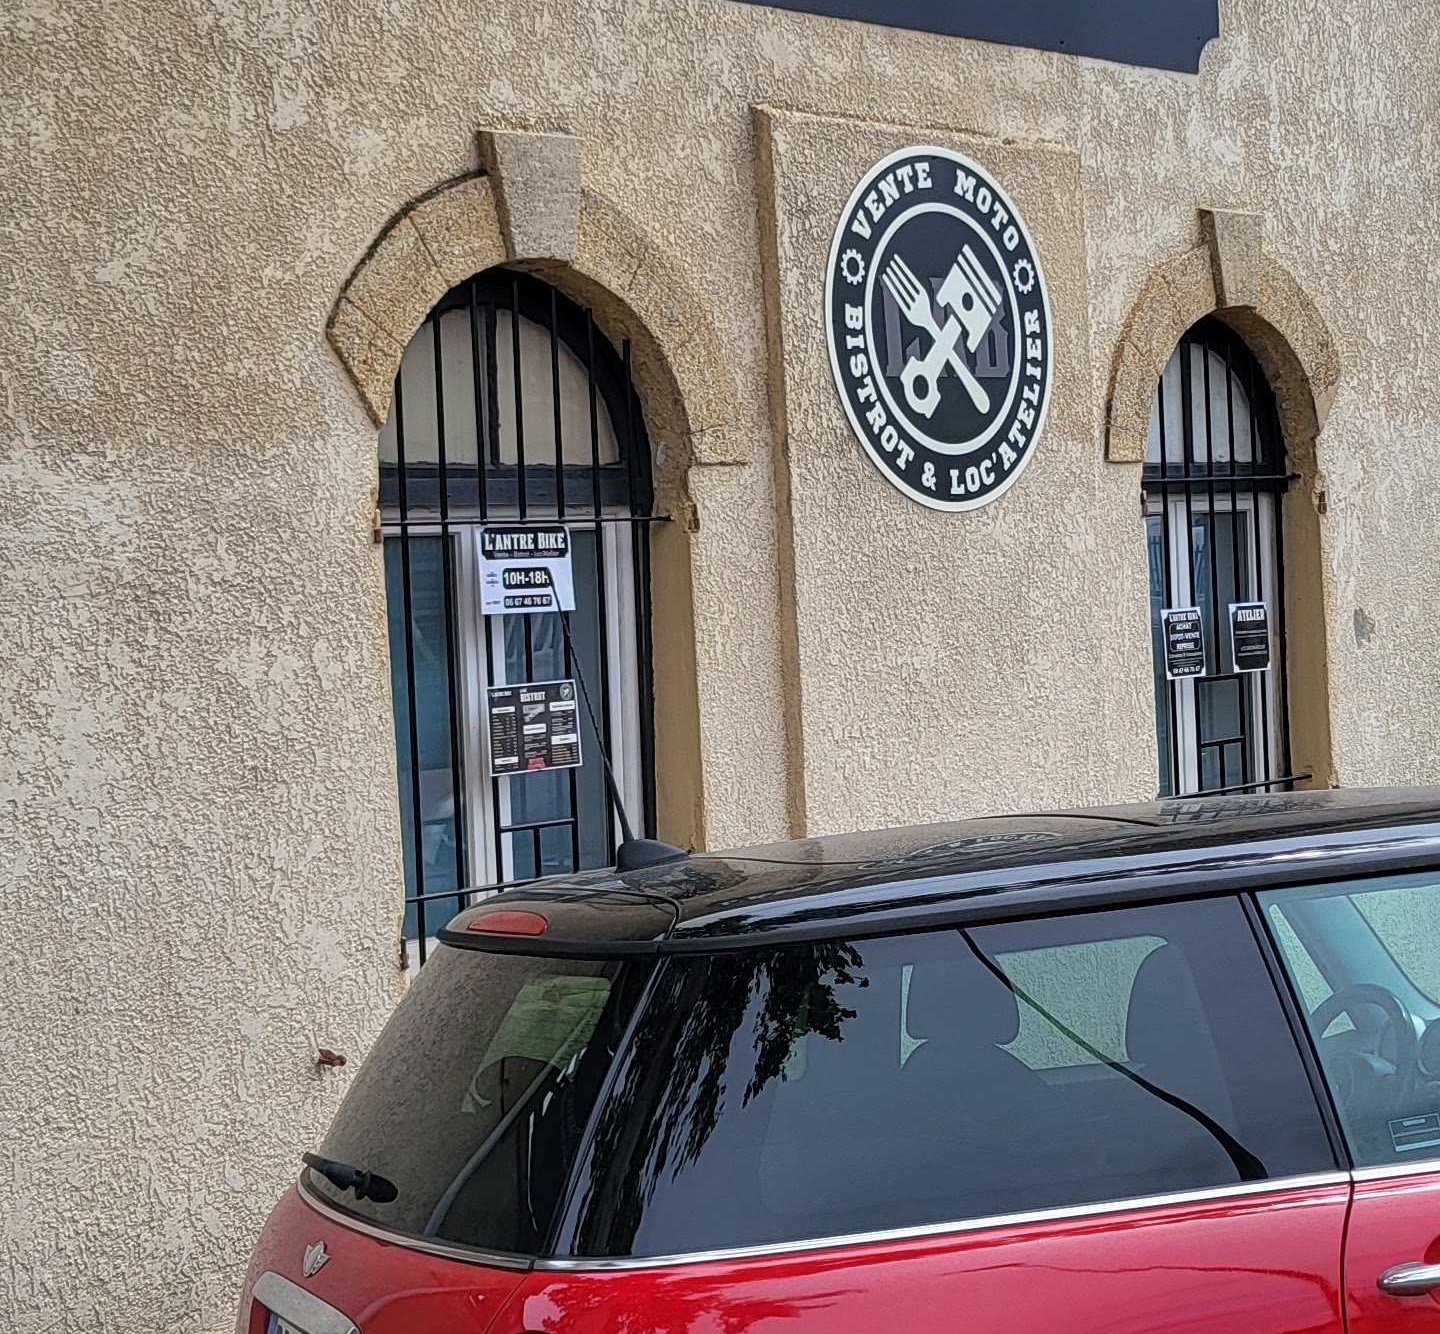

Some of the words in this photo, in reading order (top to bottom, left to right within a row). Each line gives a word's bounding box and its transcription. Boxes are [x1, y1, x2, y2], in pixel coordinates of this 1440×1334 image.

[850, 161, 933, 241] VENTE
[953, 168, 1020, 253] MOTO
[843, 304, 915, 471] BISTROT
[921, 462, 937, 492] &
[949, 308, 1042, 495] LOC'ATELIER
[484, 534, 534, 550] L'ANTRE
[537, 533, 565, 549] BIKE
[1237, 609, 1265, 621] ATELIER
